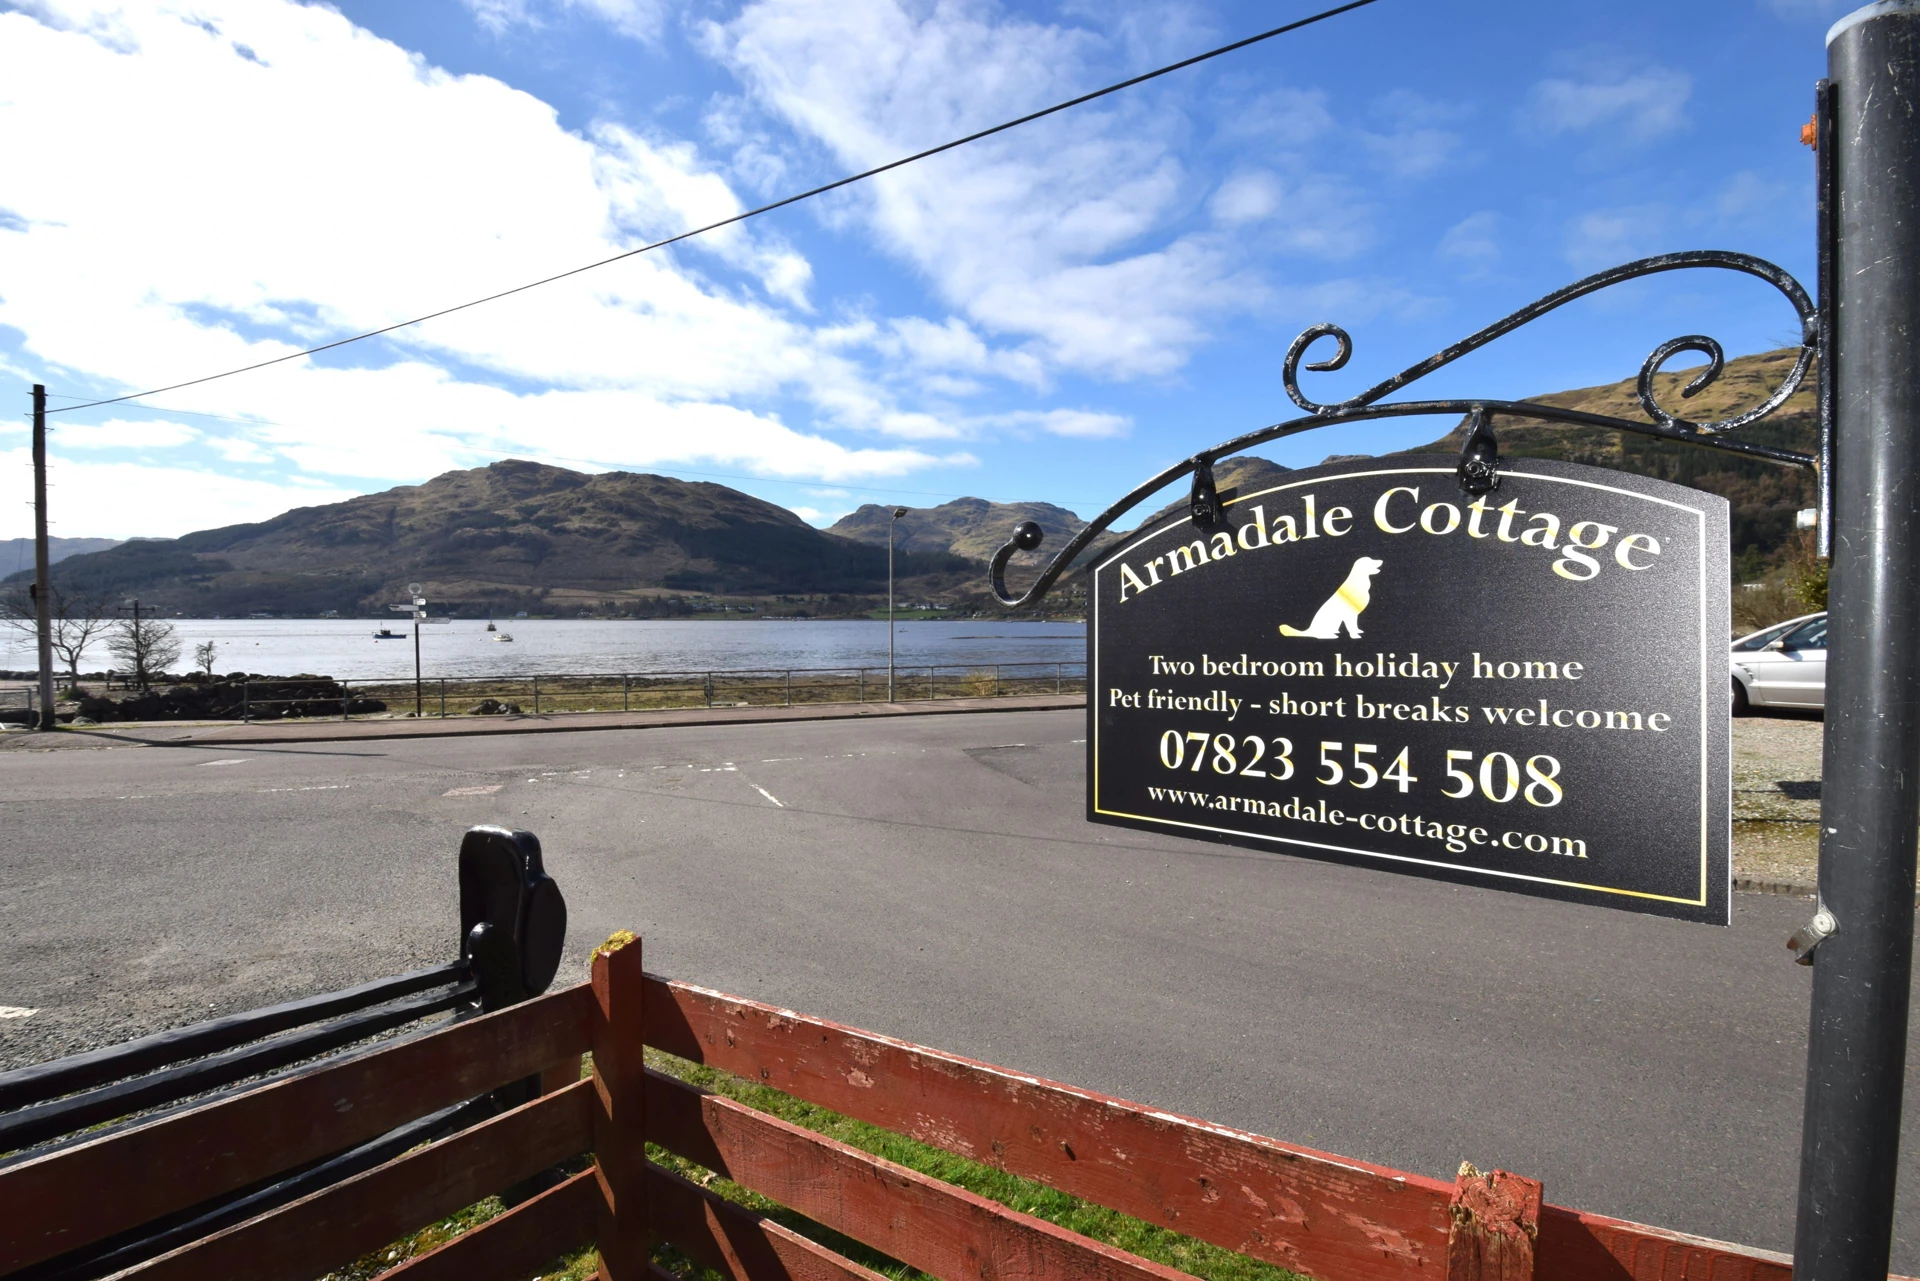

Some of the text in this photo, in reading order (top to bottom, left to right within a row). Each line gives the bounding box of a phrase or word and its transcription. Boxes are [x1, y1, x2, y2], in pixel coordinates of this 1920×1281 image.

[1120, 486, 1661, 603] Armadale Cottage
[1149, 653, 1584, 689] Two bedroom holiday home
[1110, 689, 1141, 708] Pet
[1148, 689, 1242, 720] friendly
[1270, 692, 1346, 717] short
[1357, 695, 1469, 722] breaks
[1482, 698, 1671, 731] welcome
[1160, 730, 1562, 807] 07823 554 508
[1148, 786, 1588, 859] www.armadale-cottage.com
